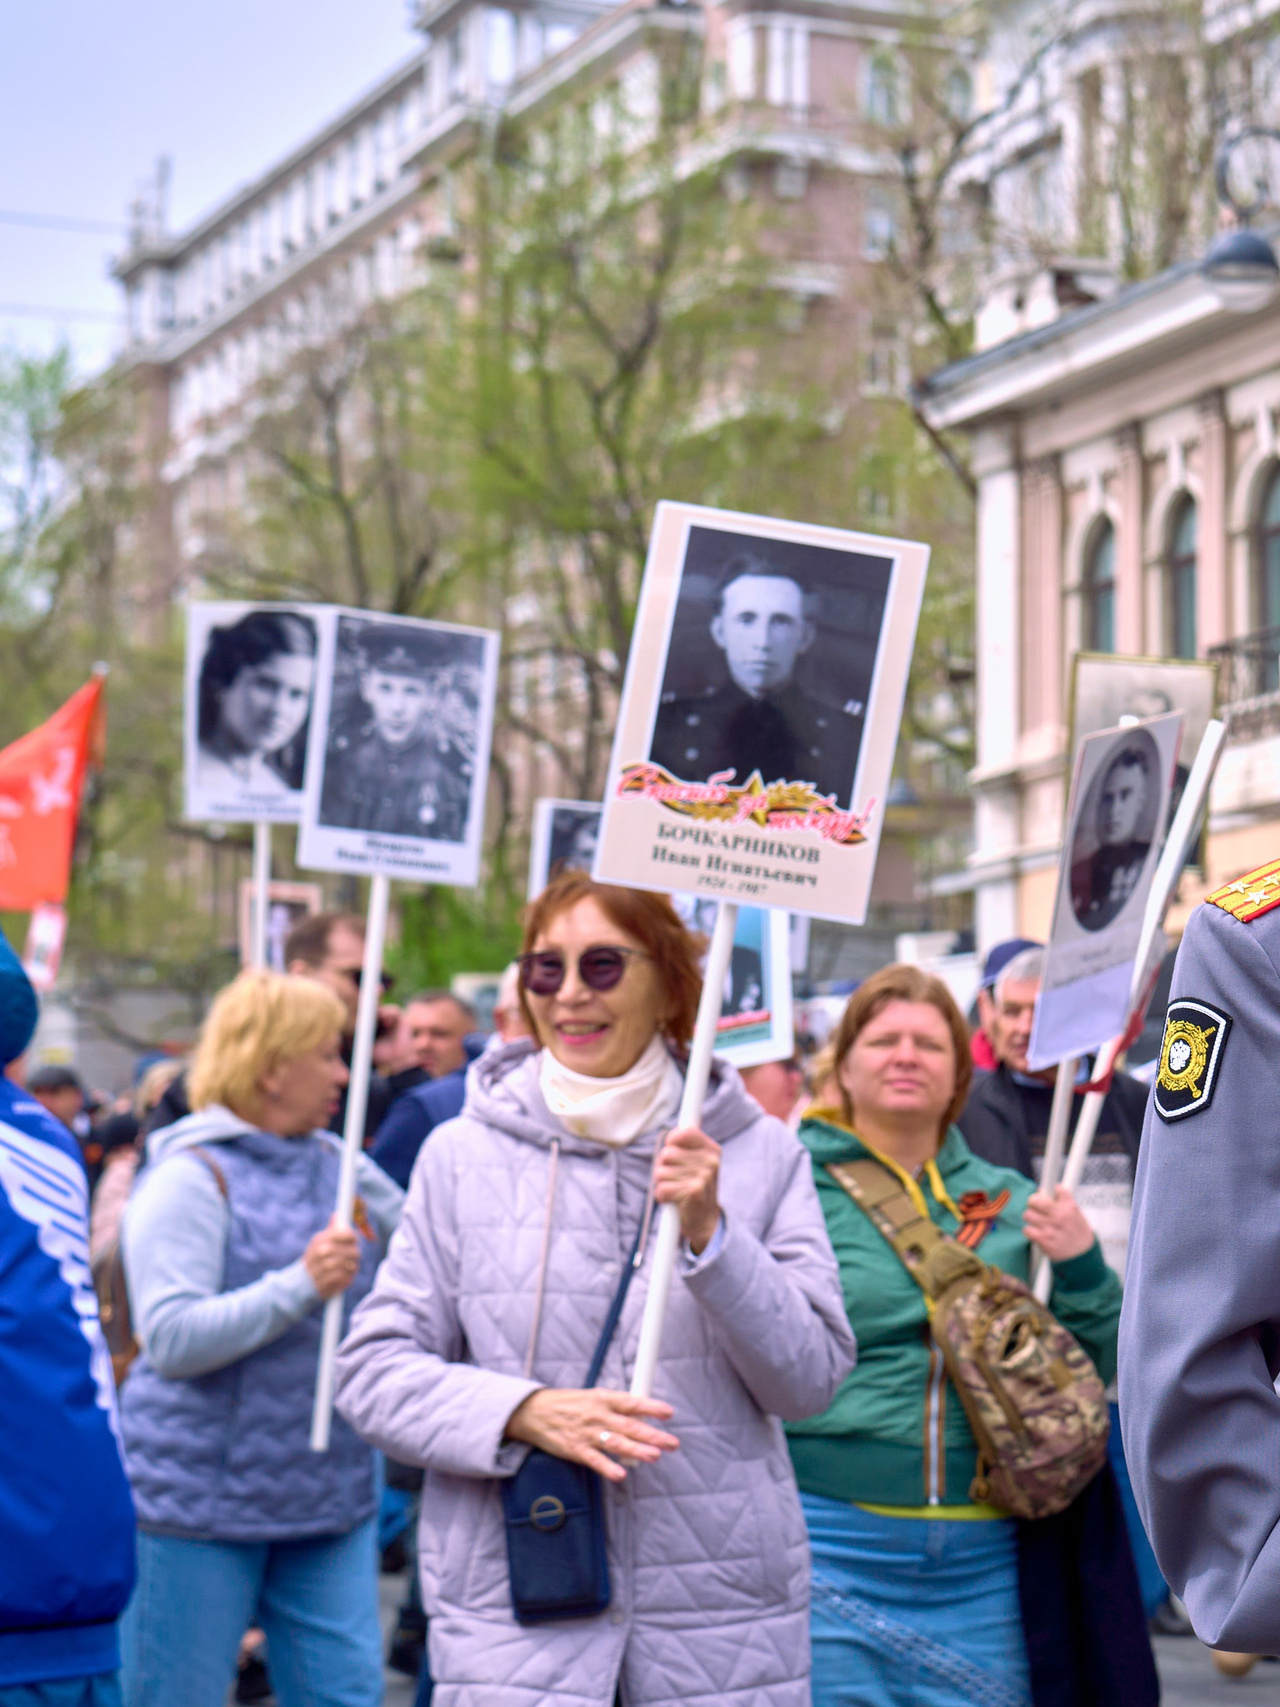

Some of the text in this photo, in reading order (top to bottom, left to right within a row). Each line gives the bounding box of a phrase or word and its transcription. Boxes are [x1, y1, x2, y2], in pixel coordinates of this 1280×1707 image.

[616, 767, 736, 803] Спасибо
[731, 794, 768, 823] за
[656, 823, 821, 864] БОЧКАРНИКОВ
[651, 845, 818, 888] Иван Игнатьевич
